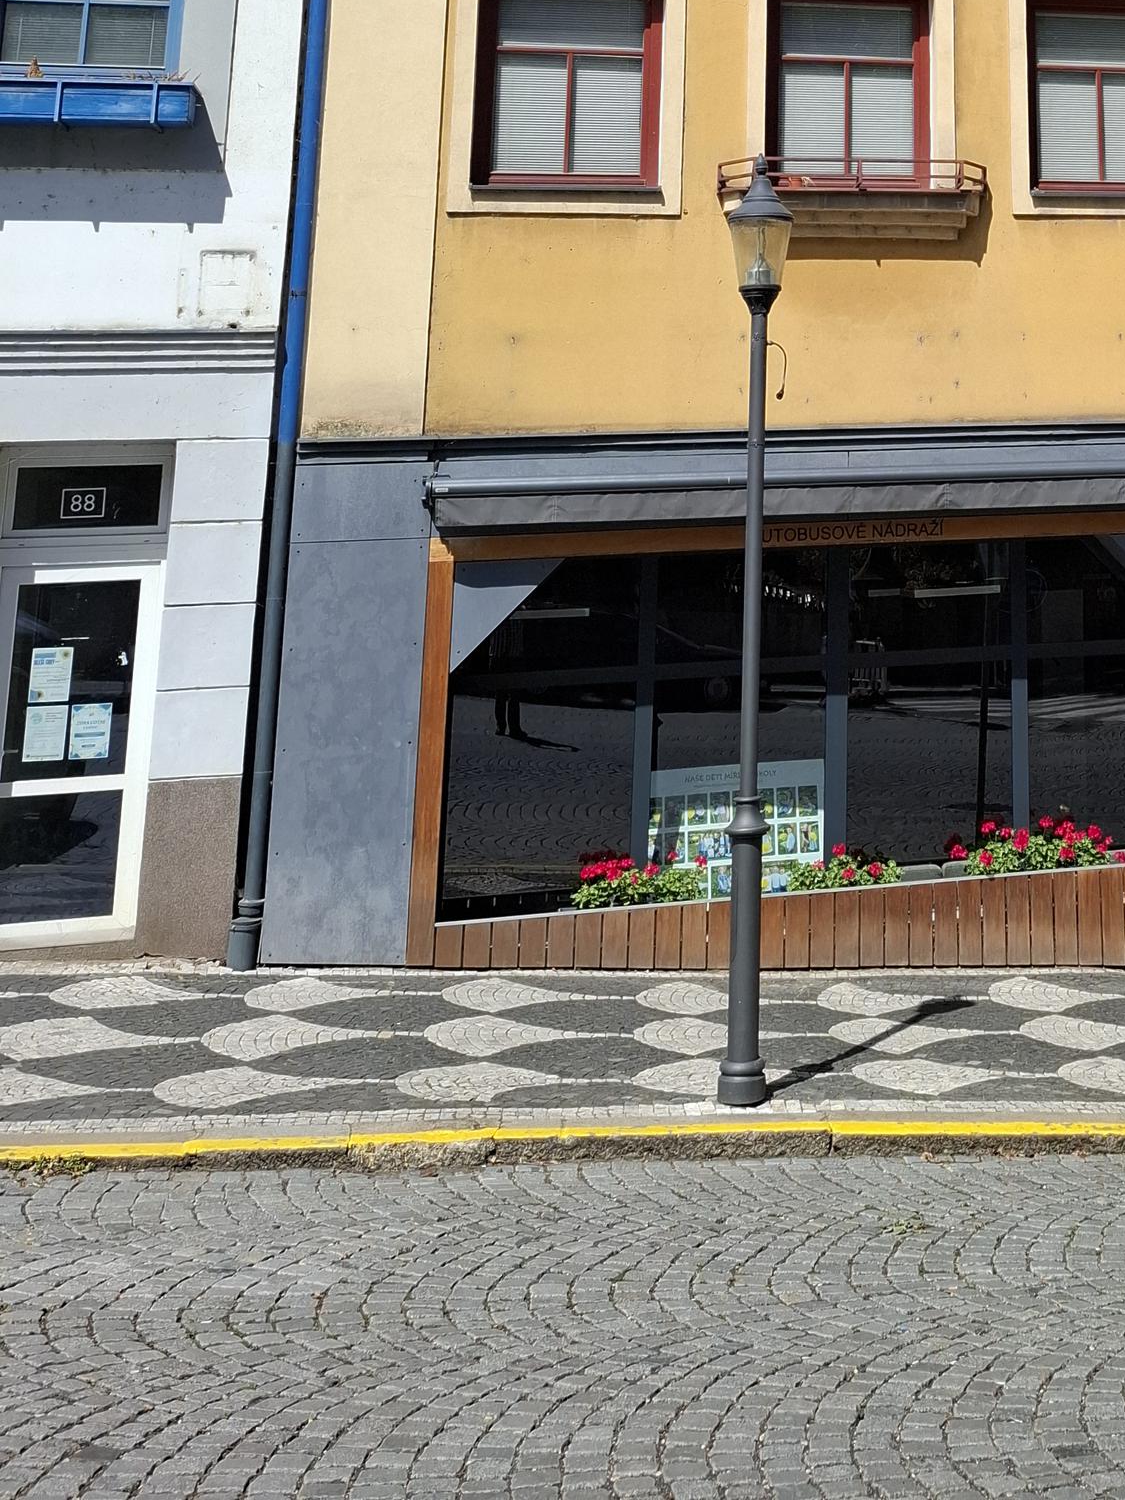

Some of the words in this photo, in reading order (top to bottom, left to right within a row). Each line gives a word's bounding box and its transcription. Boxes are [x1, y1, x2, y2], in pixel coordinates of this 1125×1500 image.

[70, 494, 95, 512] 88
[762, 523, 866, 543] UTOBUSOVÉ
[872, 517, 944, 538] NÁDRAŽÍ
